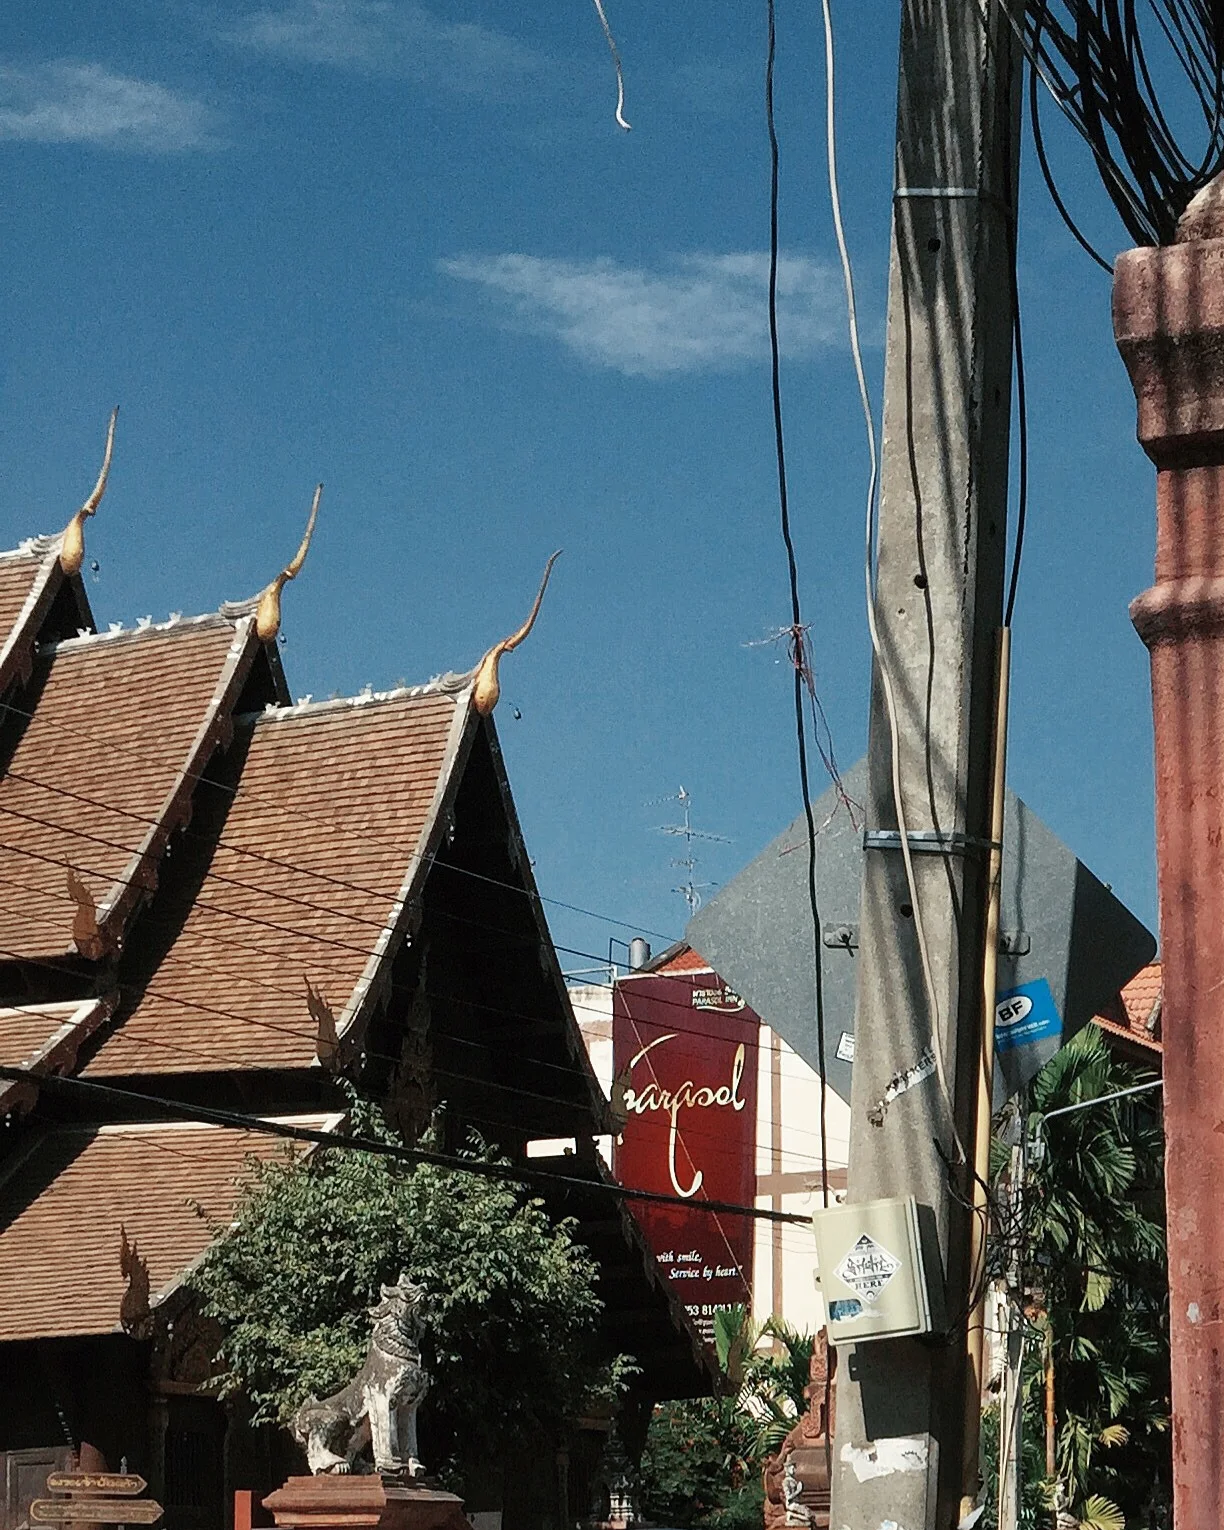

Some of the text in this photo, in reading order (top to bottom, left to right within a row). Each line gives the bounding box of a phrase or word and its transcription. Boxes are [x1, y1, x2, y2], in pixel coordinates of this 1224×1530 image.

[998, 1000, 1024, 1022] BF
[668, 1267, 700, 1279] Service
[684, 1304, 699, 1316] 53
